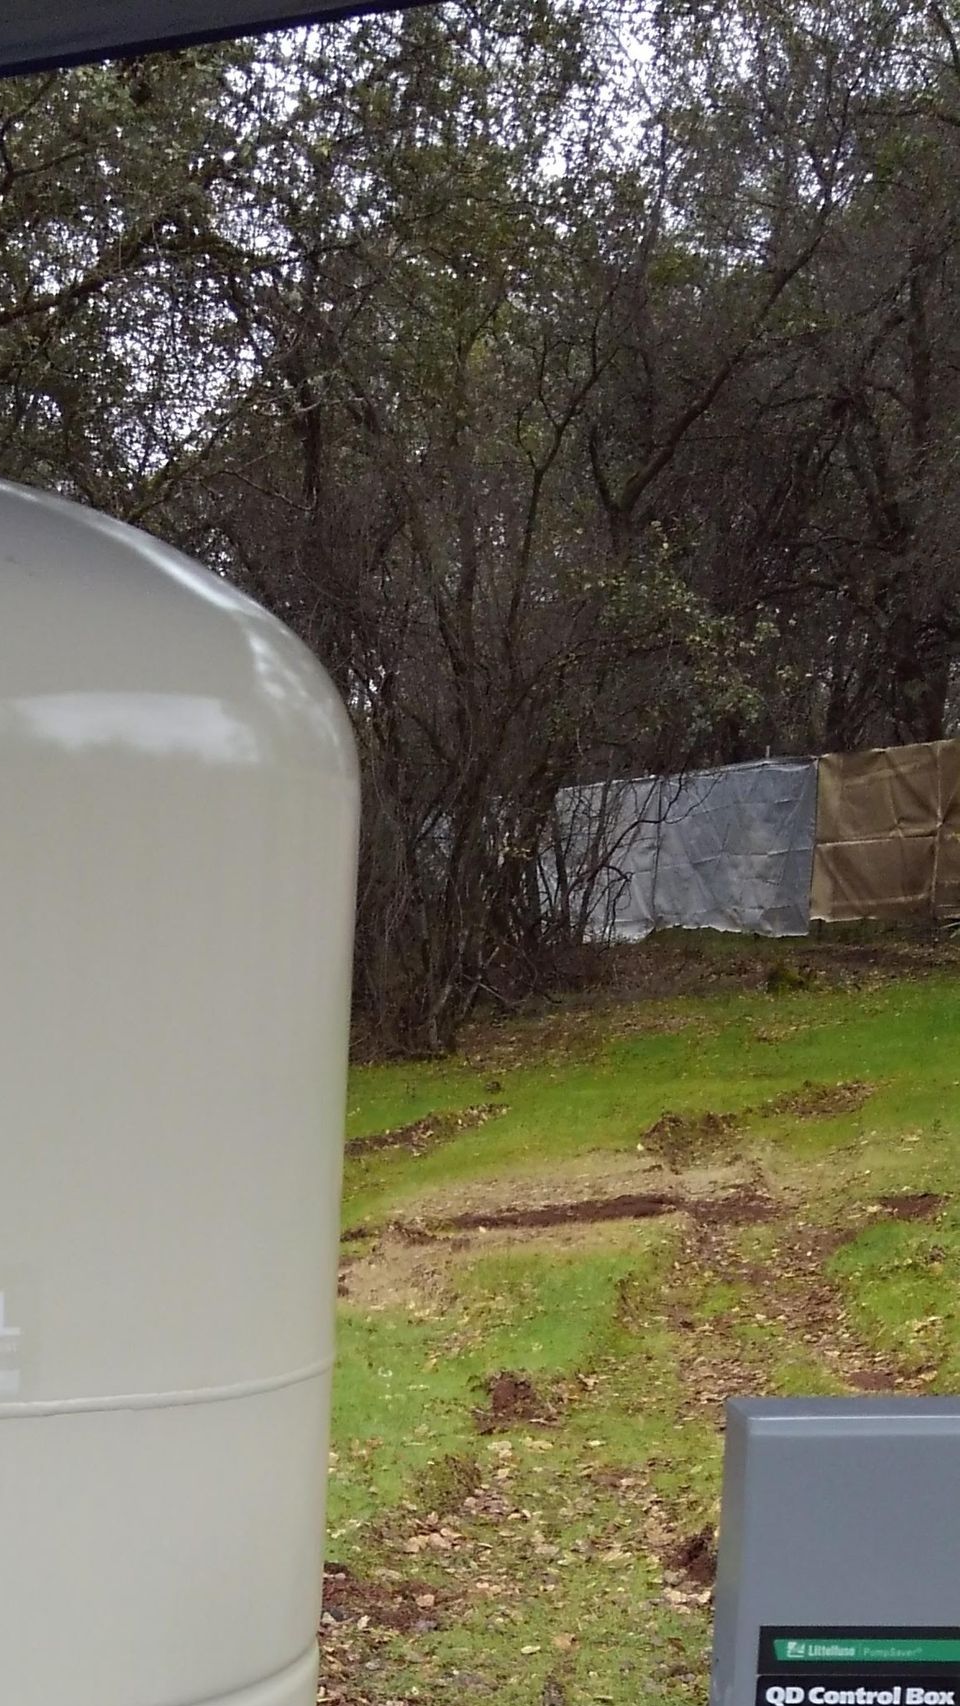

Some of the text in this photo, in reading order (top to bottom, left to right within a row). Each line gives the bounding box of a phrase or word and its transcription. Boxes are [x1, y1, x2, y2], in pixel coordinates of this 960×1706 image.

[765, 1686, 955, 1706] QD Control Box
